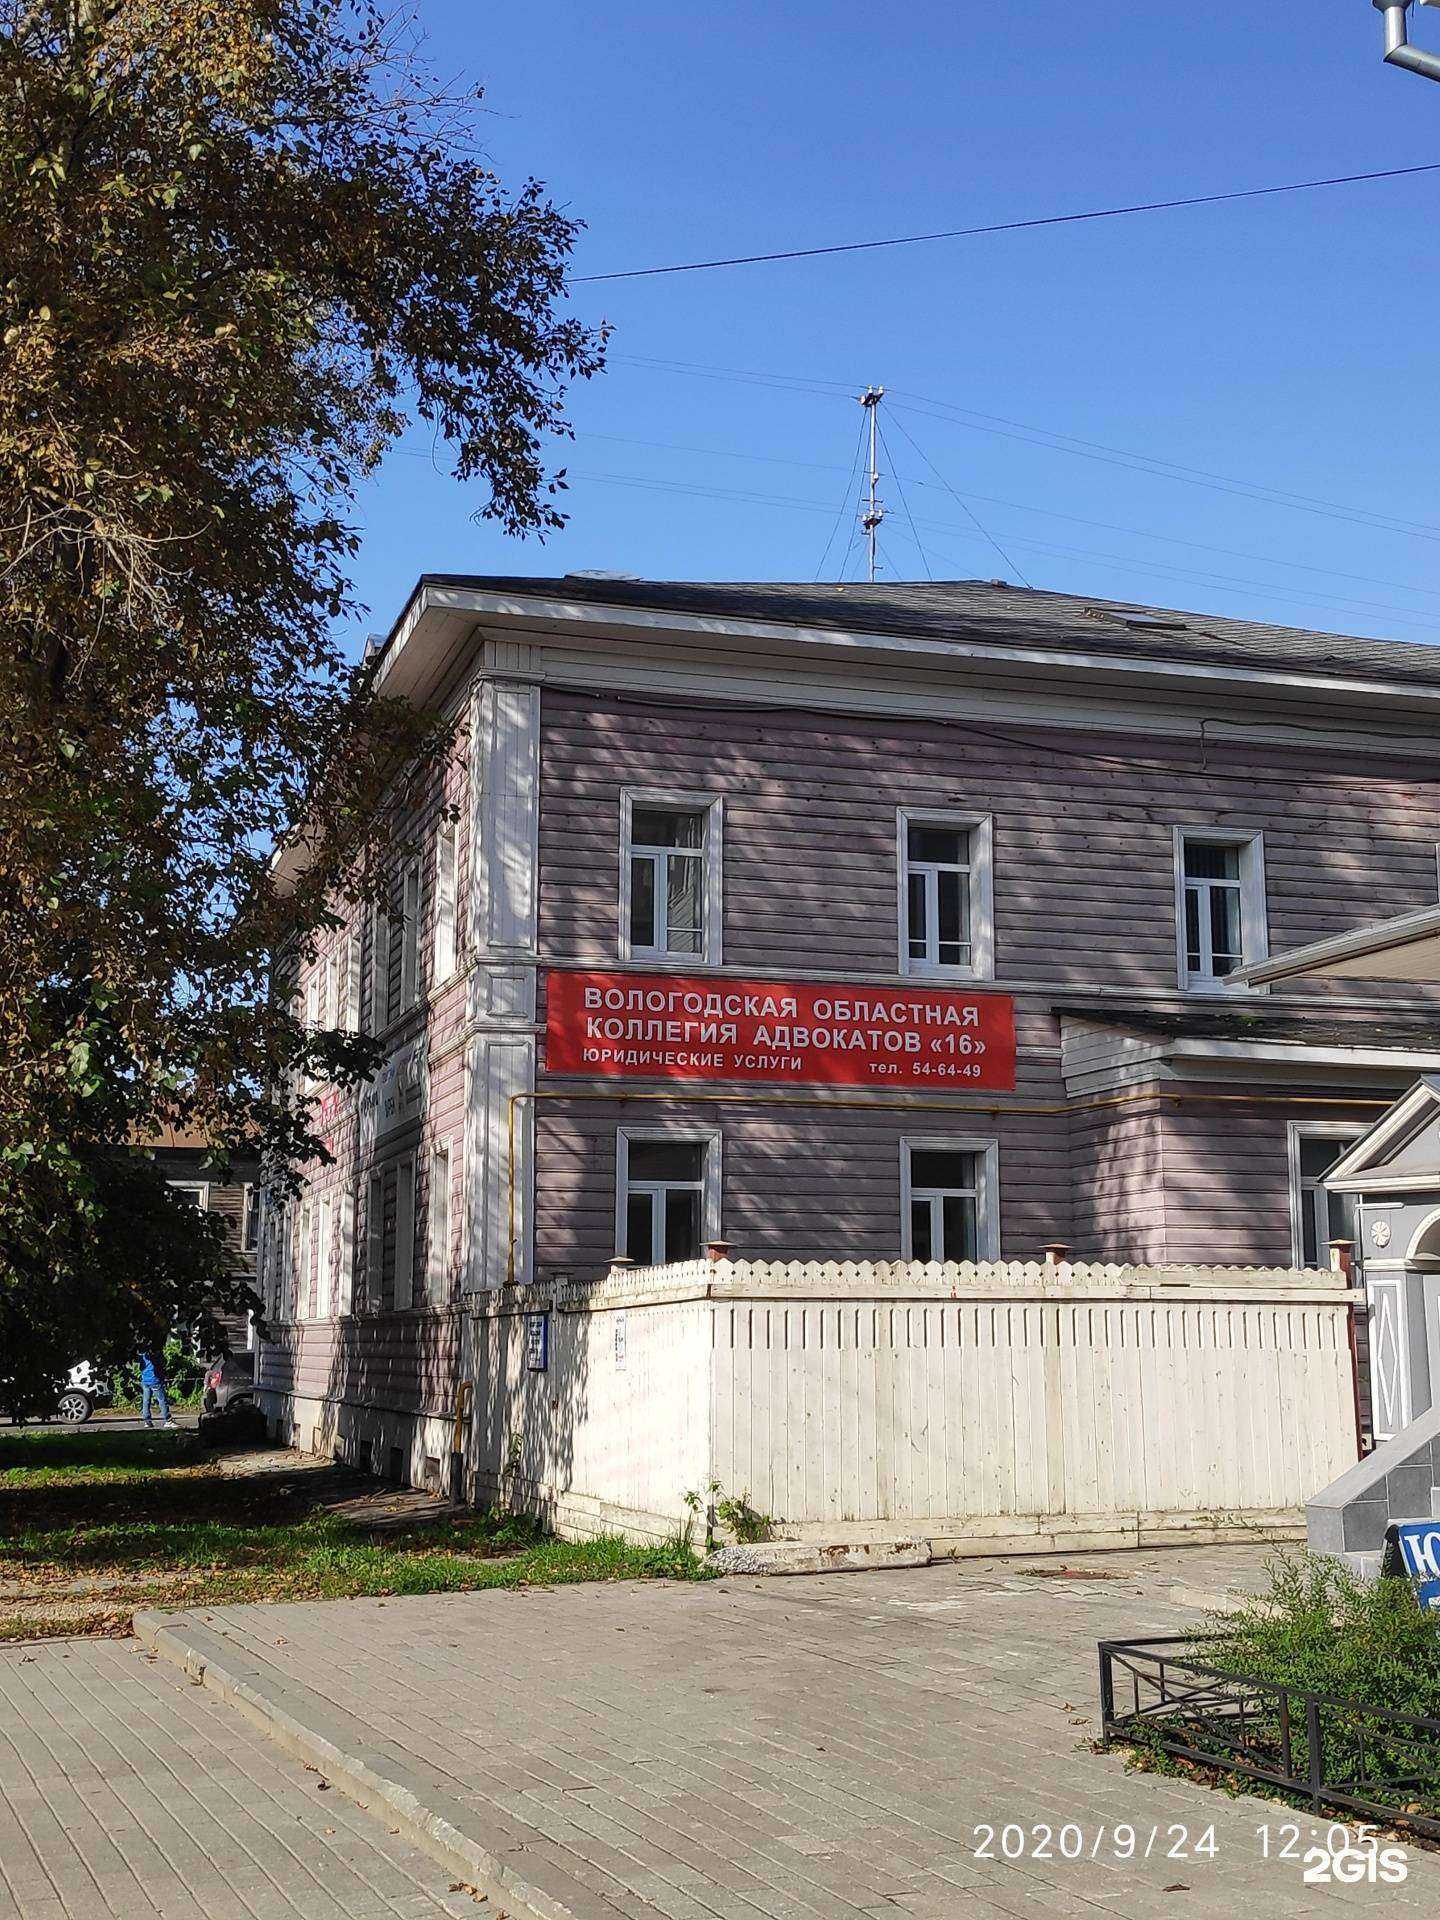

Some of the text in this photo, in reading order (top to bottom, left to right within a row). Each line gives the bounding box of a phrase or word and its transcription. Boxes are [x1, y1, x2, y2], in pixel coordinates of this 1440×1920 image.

[584, 987, 979, 1027] ВОЛОГОДСКАЯ ОБЛАСТНАЯ
[586, 1016, 986, 1055] КОЛЛЕГИЯ АДВОКАТОВ «16»
[583, 1047, 802, 1071] ЮРИДИЧЕСКИЕ УСЛУГИ
[869, 1061, 982, 1079] тел. 54-64-49
